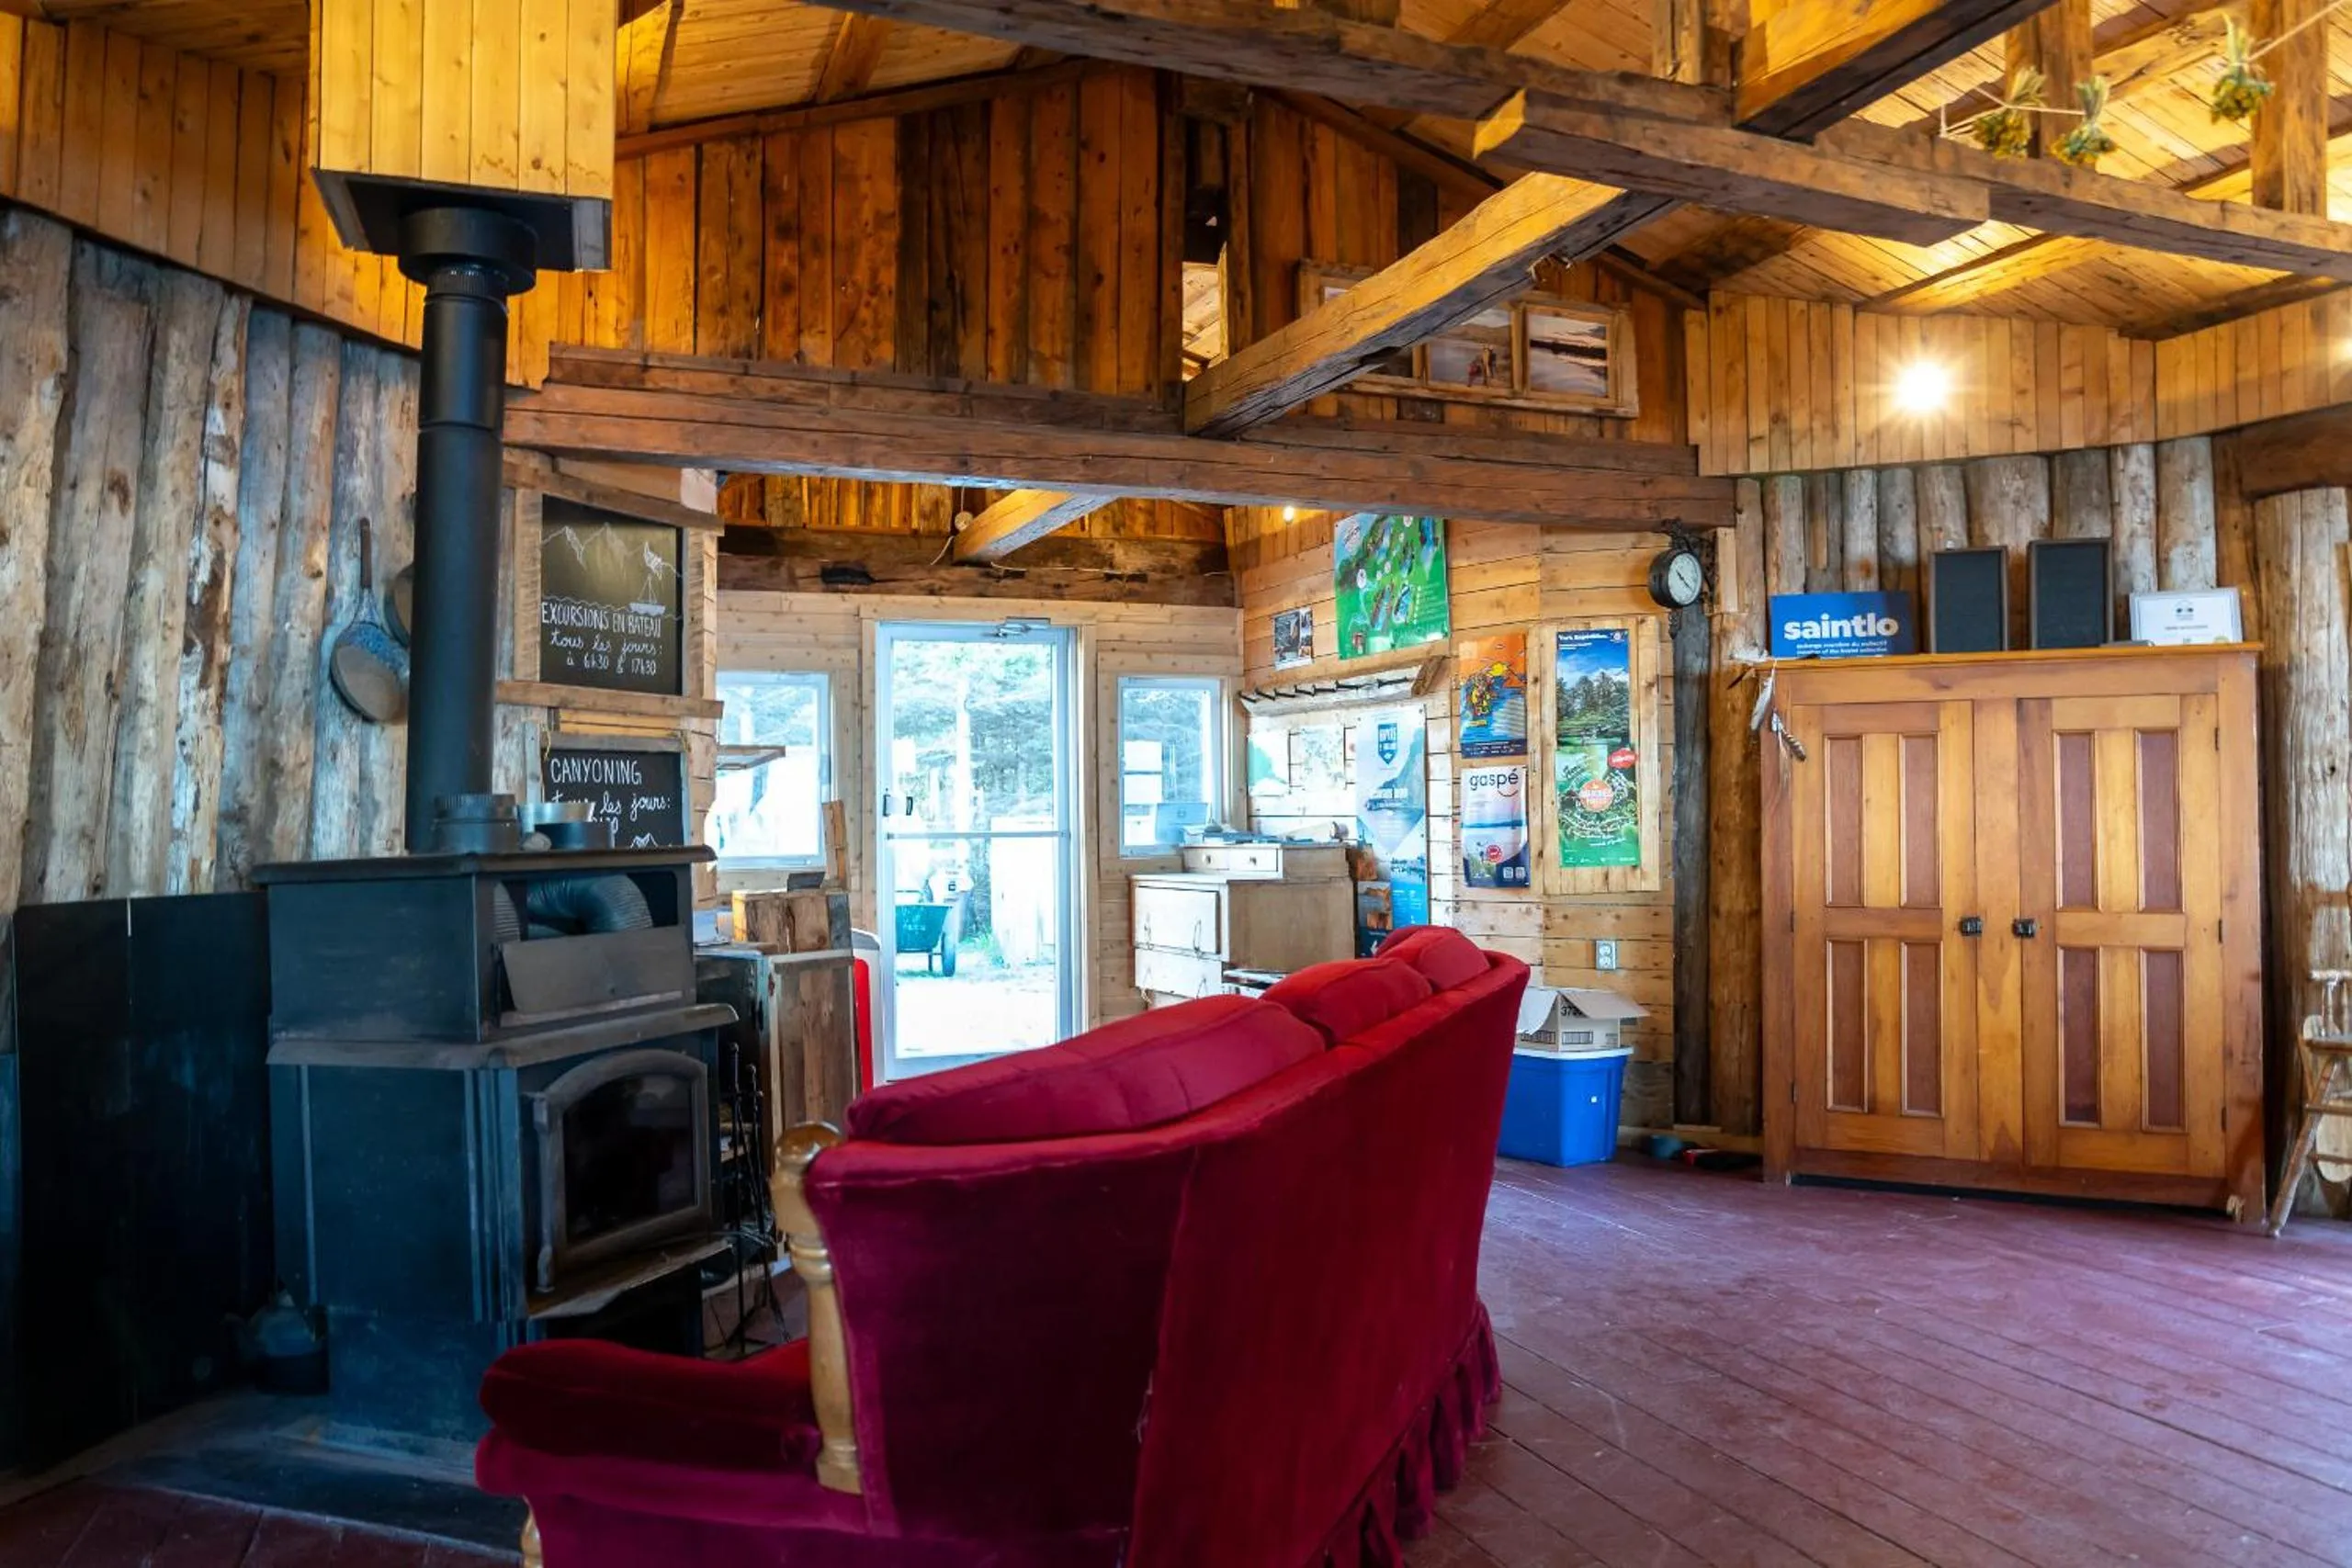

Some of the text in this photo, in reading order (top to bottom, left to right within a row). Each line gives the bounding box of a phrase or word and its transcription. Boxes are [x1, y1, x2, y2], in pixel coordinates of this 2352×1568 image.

[541, 602, 609, 631] EXCURSIONS
[613, 613, 625, 633] EN
[1783, 613, 1900, 640] saintlo
[550, 628, 584, 649] tous
[592, 633, 612, 652] les
[550, 757, 642, 785] CANYONING
[1470, 768, 1519, 791] gaspé
[600, 791, 621, 814] les
